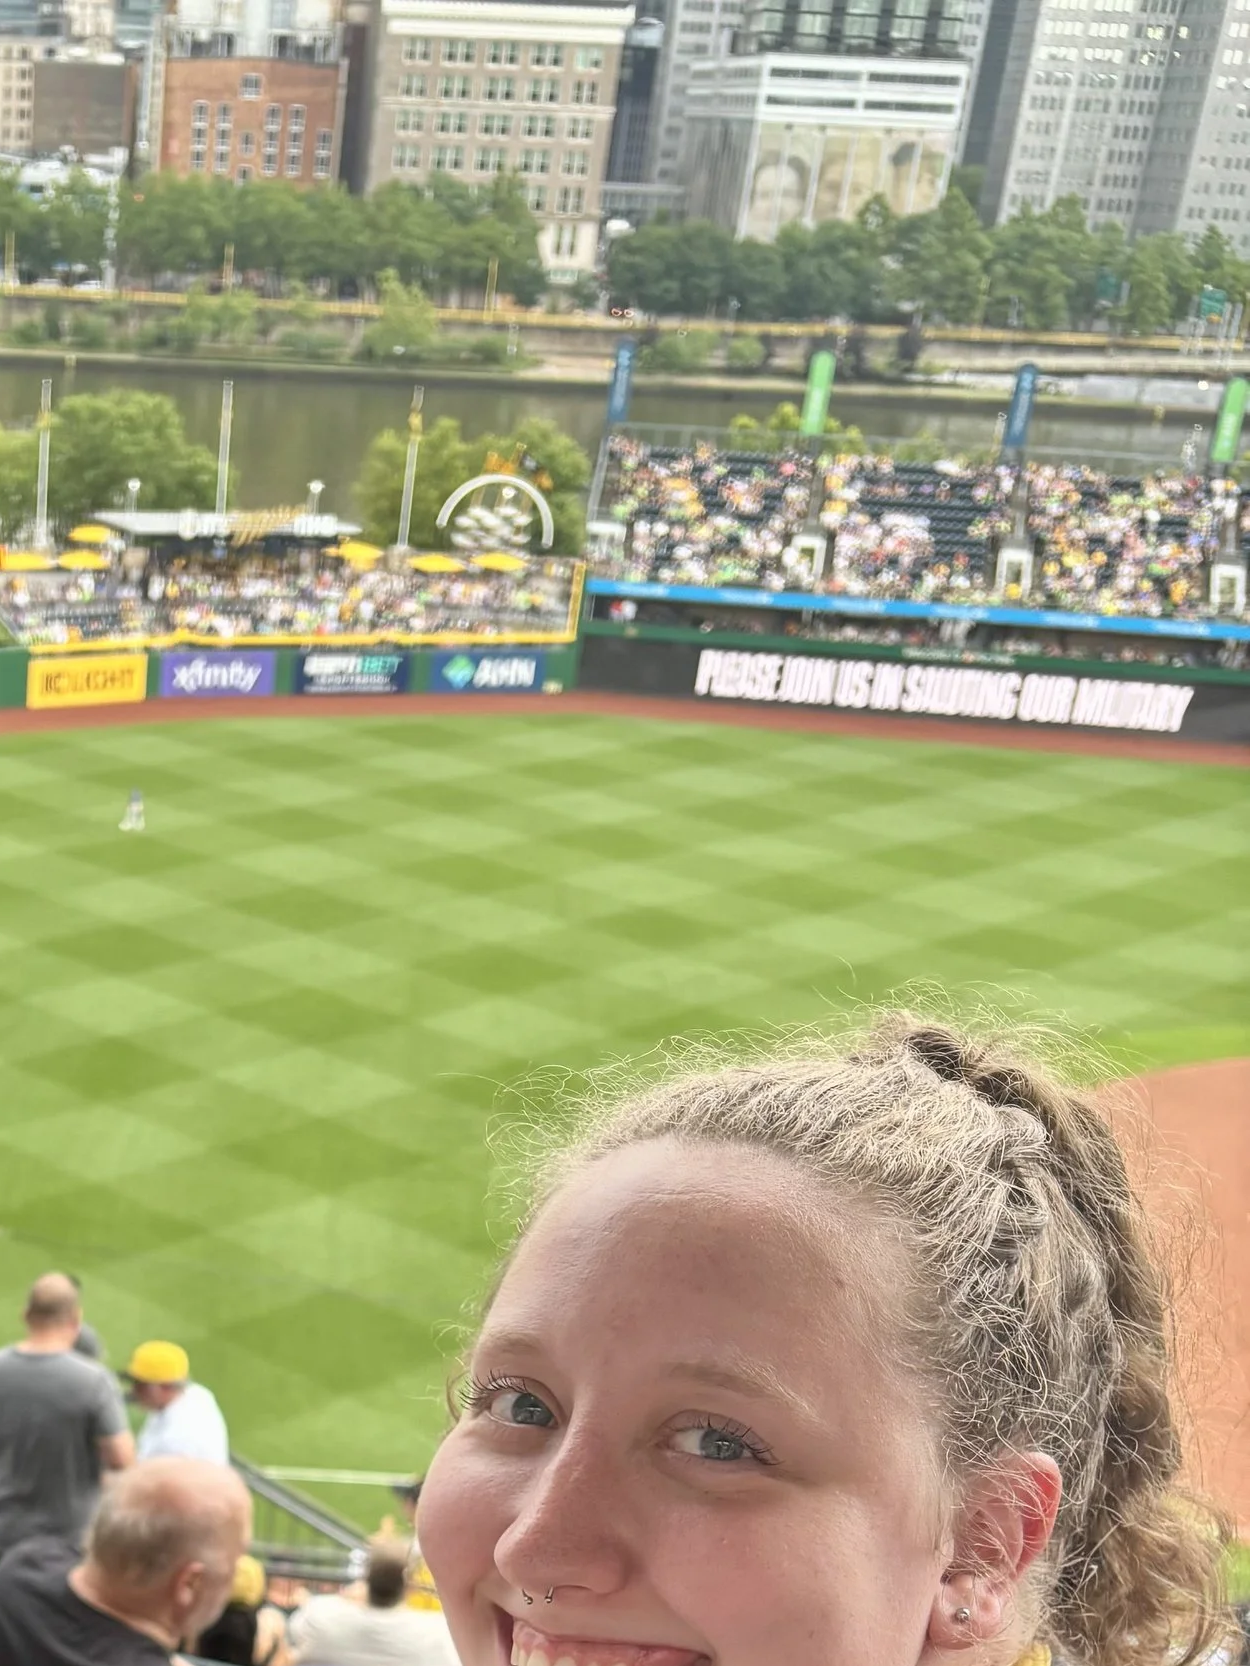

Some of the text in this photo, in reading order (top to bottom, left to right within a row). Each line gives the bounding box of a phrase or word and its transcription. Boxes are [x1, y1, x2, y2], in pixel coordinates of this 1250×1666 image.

[172, 657, 262, 692] xfinity
[695, 649, 784, 701] PLEASE
[833, 660, 875, 708] US
[868, 663, 906, 710] IN
[902, 664, 1022, 720] SALUTING
[1017, 673, 1078, 724] OUR
[1071, 678, 1195, 732] MILITARY
